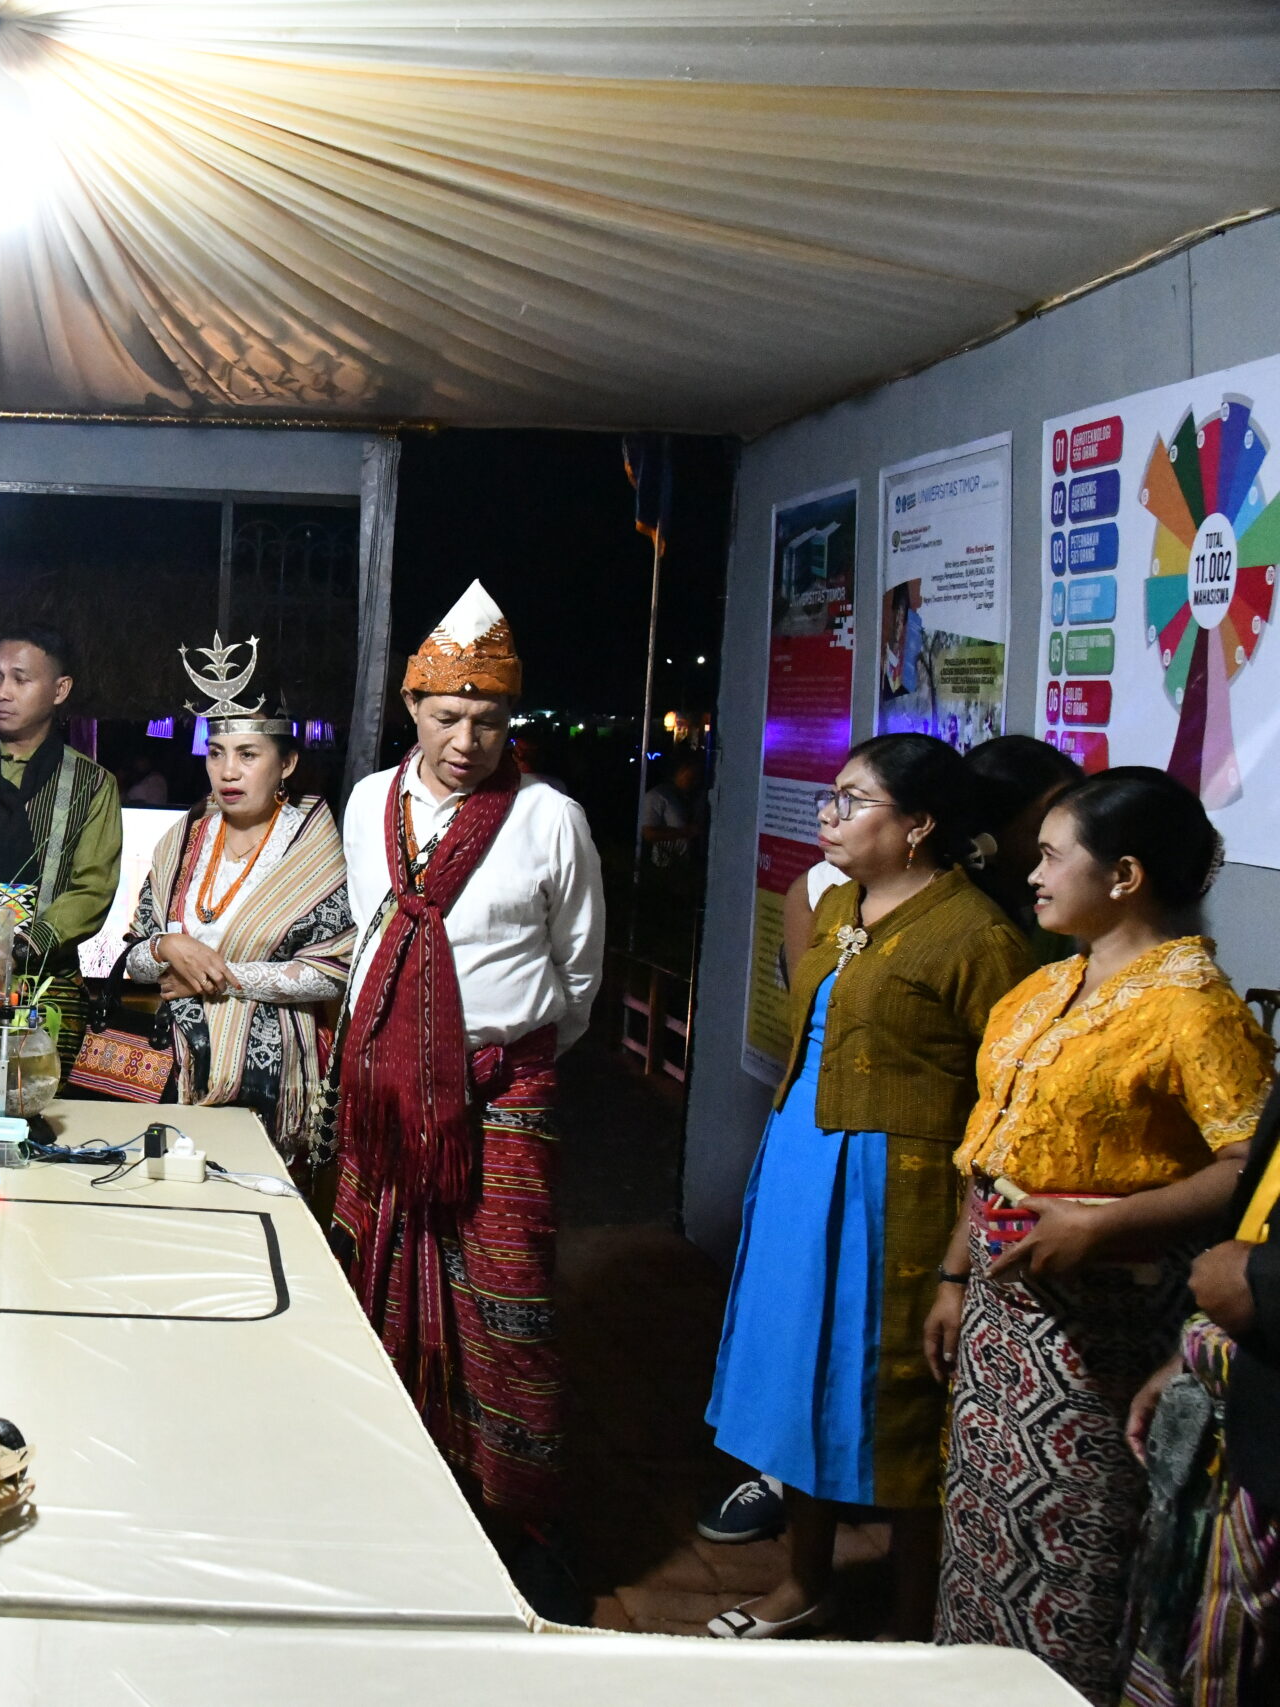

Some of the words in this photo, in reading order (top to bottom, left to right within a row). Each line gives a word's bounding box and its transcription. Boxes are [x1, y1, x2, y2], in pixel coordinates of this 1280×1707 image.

[1055, 438, 1065, 463] 01
[1053, 492, 1064, 515] 02
[1053, 539, 1063, 564] 03
[1206, 532, 1223, 549] TOTAL
[1195, 550, 1232, 584] 11.002
[1193, 588, 1229, 607] MAHASISWA
[1050, 638, 1060, 661] 05
[1048, 688, 1058, 711] 06
